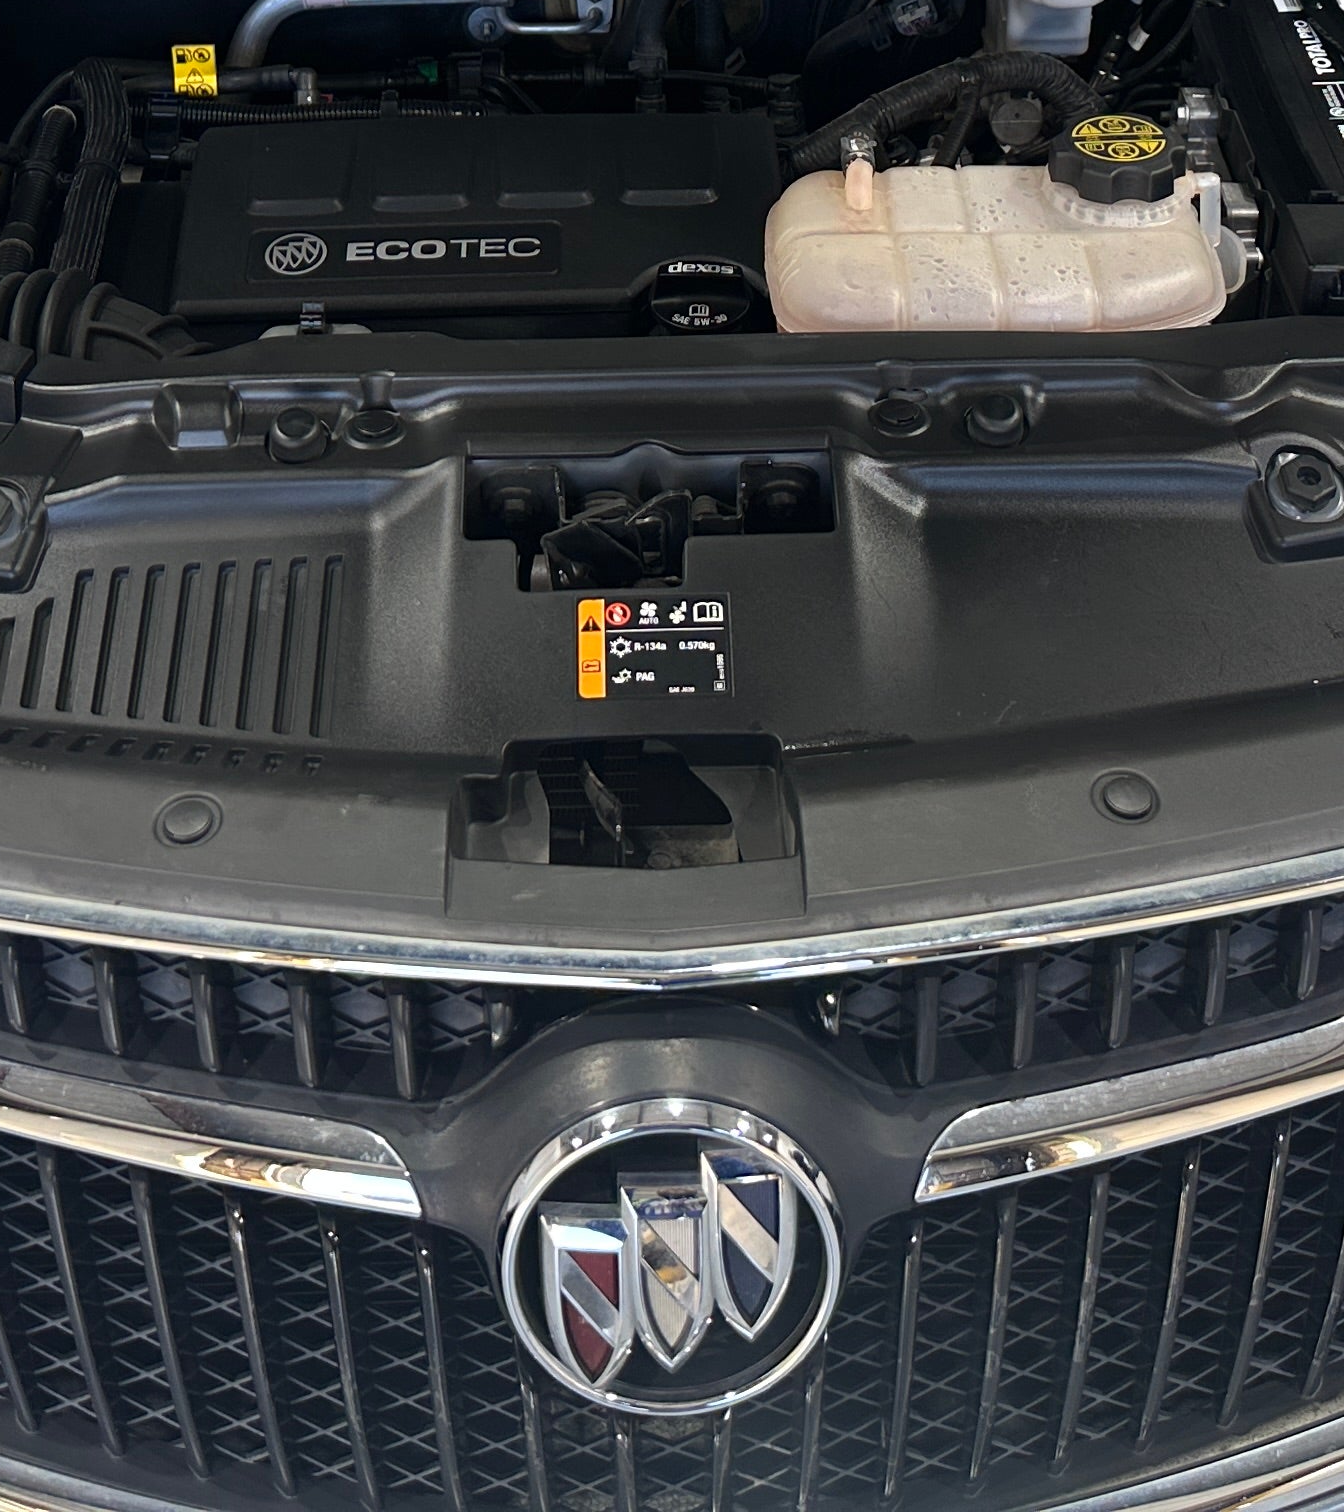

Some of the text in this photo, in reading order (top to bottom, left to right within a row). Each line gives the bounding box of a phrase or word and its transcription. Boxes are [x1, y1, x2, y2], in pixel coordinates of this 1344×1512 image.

[1293, 20, 1335, 75] TOTALPRO
[345, 236, 543, 262] ECOTEC
[668, 261, 734, 274] dexos
[671, 313, 728, 326] SAE 5W-30
[638, 616, 659, 625] AUTO
[633, 640, 667, 651] R-134a
[635, 671, 655, 682] PAG
